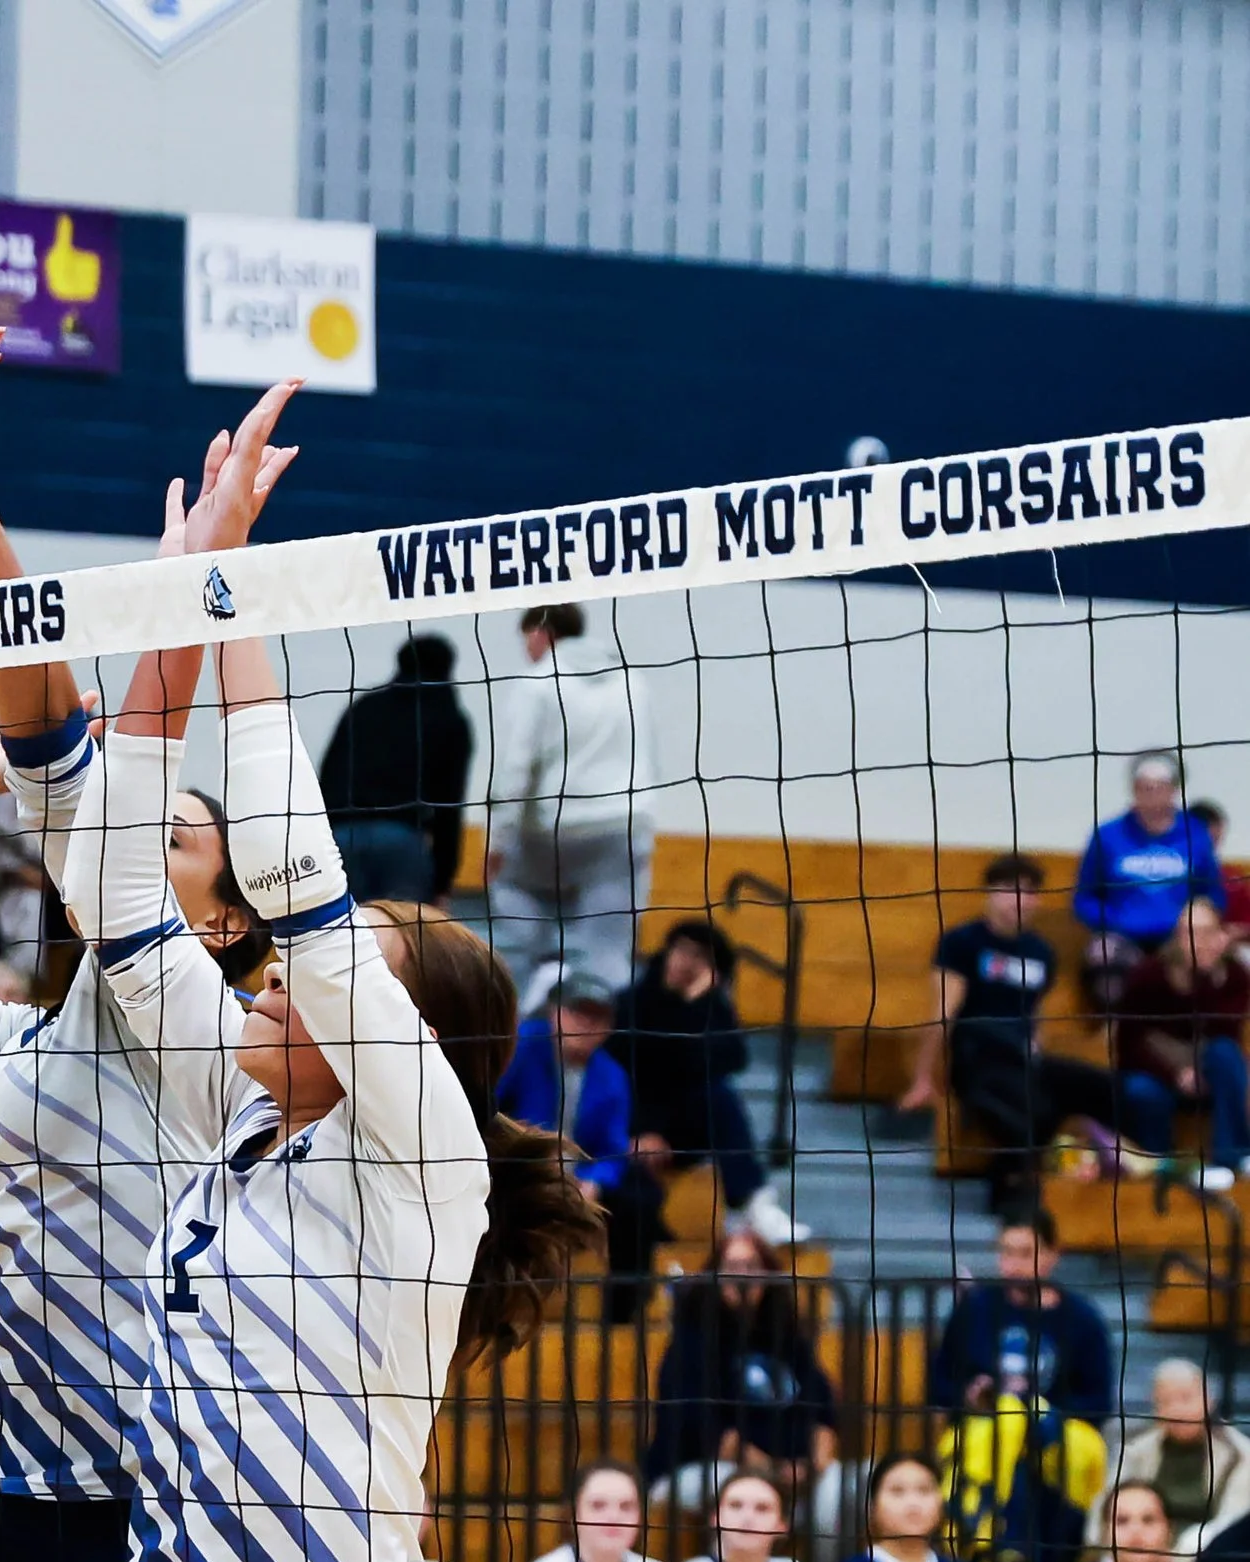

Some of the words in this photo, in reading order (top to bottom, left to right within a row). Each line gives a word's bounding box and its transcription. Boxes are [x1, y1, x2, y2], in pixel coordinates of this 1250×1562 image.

[378, 498, 688, 600] WATERFORD
[714, 474, 873, 561] MOTT
[901, 432, 1206, 540] CORSAIRS
[165, 1218, 220, 1314] 1
